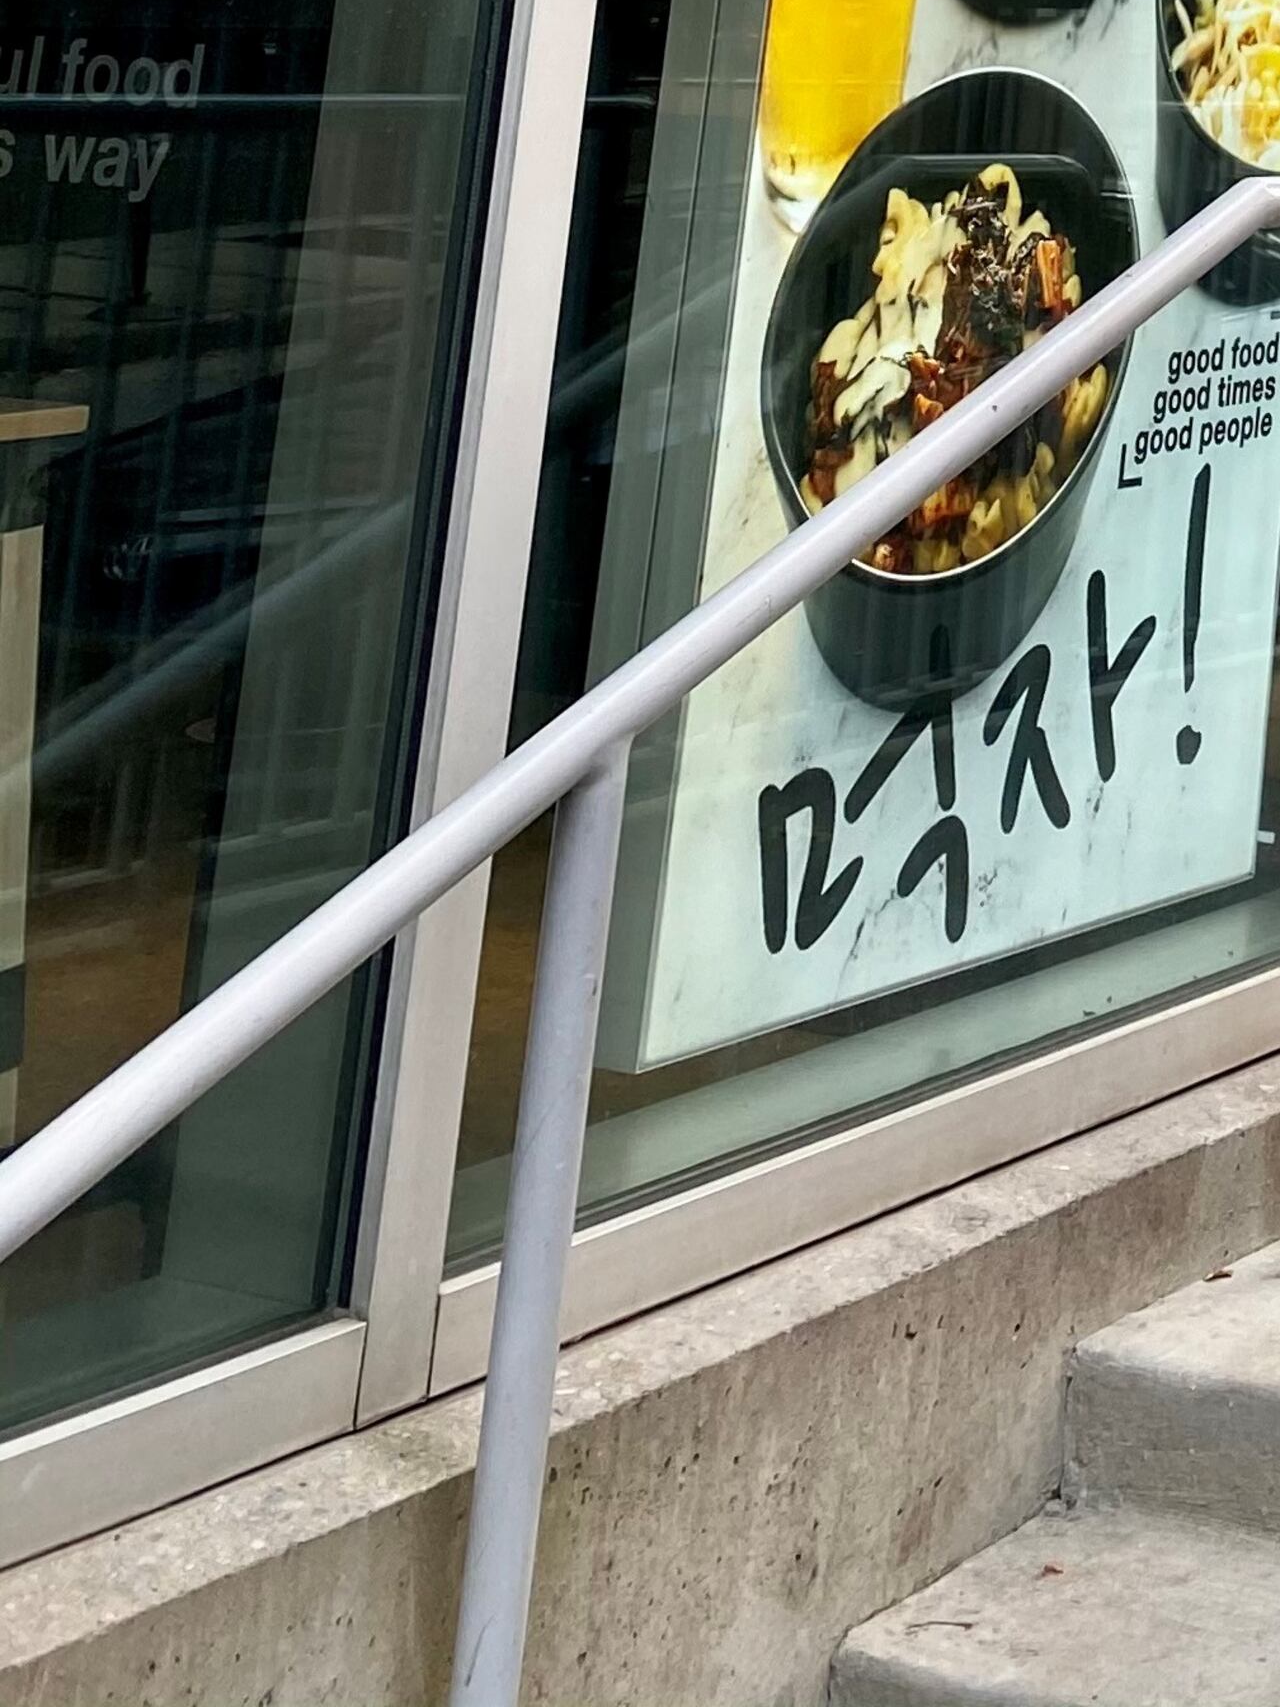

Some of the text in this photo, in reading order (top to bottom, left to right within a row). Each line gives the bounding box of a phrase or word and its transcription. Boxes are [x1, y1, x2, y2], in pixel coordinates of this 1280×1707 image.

[62, 38, 206, 109] food
[45, 133, 170, 203] way
[1167, 331, 1280, 384] good food
[1152, 374, 1276, 424] good times
[1133, 406, 1273, 465] good people
